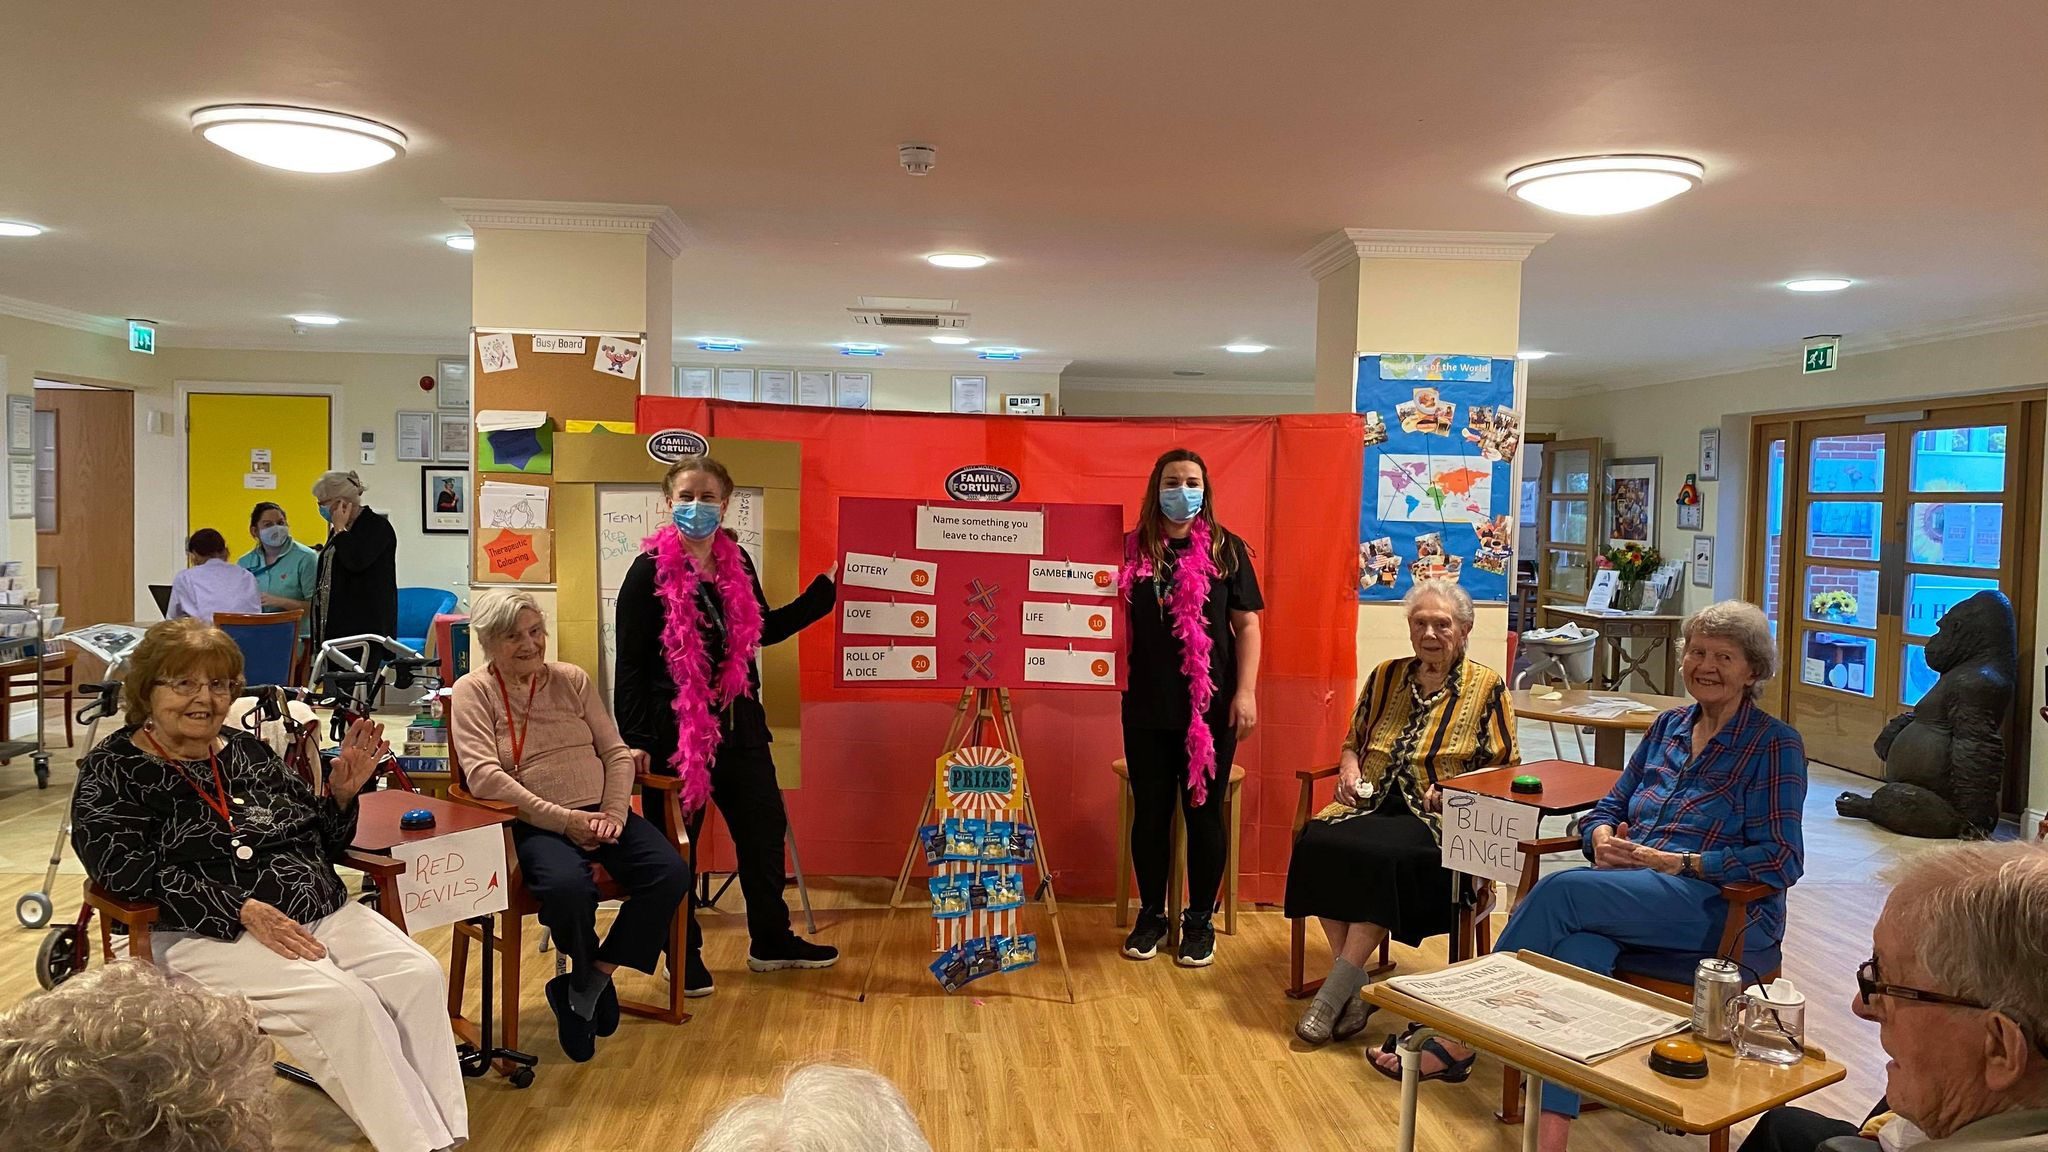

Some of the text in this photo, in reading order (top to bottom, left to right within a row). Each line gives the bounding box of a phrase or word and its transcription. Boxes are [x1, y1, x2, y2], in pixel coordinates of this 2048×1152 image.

[536, 338, 583, 350] Busy Board
[1430, 361, 1440, 373] of
[1442, 362, 1457, 372] the
[1460, 363, 1489, 373] World
[661, 437, 694, 446] FAMILY
[655, 444, 701, 453] FORTUNES
[960, 473, 1003, 483] FAMILY
[953, 483, 1013, 493] FORTUNES
[603, 511, 642, 524] TEAM
[933, 514, 1028, 529] Name something you
[602, 528, 626, 542] RED
[942, 530, 1018, 543] leave to chance?
[488, 539, 528, 558] Therapeutic
[496, 553, 530, 569] Colouring
[846, 563, 889, 576] LOTTERY
[1032, 567, 1094, 580] GAMBELING
[914, 574, 926, 583] 30
[1098, 575, 1108, 584] 15
[846, 608, 872, 619] LOVE
[1025, 612, 1044, 622] LIFE
[914, 615, 926, 624] 25
[1092, 619, 1103, 628] 10
[846, 651, 886, 661] ROLL OF
[1027, 656, 1046, 666] JOB
[915, 660, 927, 669] 20
[1097, 664, 1103, 673] 5
[845, 667, 878, 677] A DICE
[952, 769, 1010, 789] PRIZES
[1457, 807, 1520, 841] BLUE
[415, 853, 464, 884] RED
[404, 878, 479, 914] DEVILS
[1461, 965, 1508, 981] TIMES
